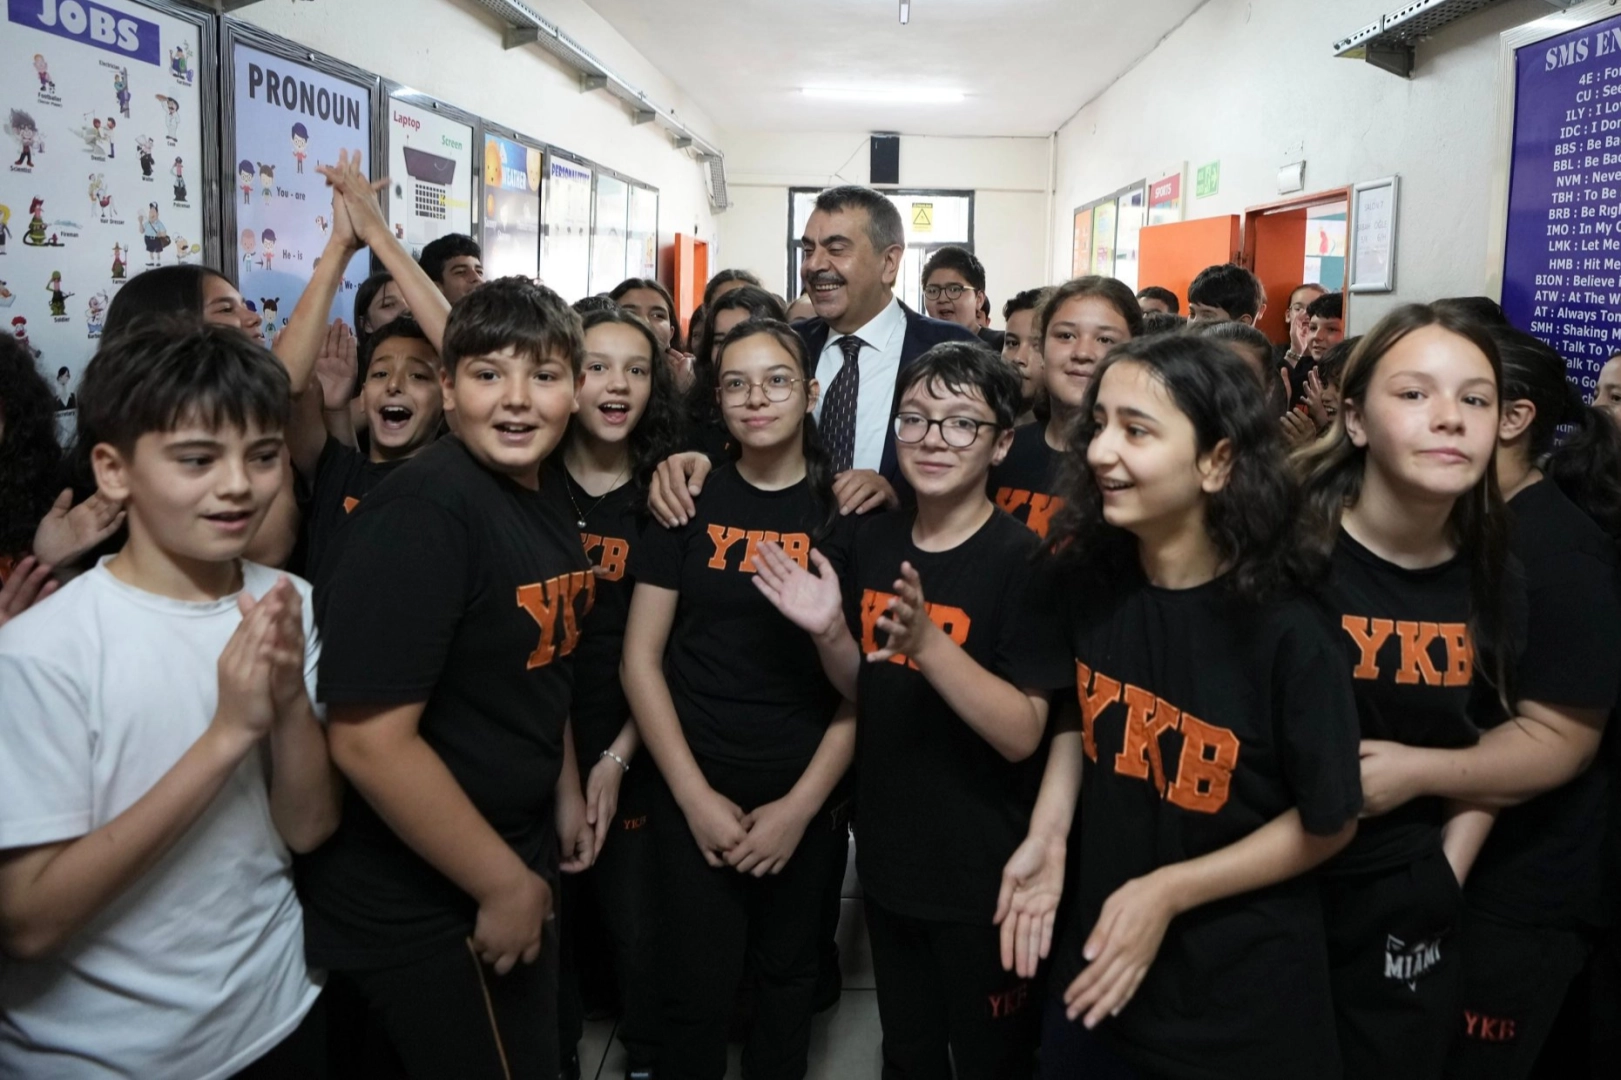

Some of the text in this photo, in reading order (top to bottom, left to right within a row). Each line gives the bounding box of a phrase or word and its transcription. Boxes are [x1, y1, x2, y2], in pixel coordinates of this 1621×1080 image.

[37, 0, 139, 51] JOBS
[1545, 37, 1589, 71] SMS
[1579, 72, 1593, 86] 4E
[249, 62, 360, 130] PRONOUN
[1576, 89, 1591, 103] CU
[393, 110, 421, 131] Laptop
[1566, 107, 1585, 122] ILY
[1596, 103, 1601, 116] I
[1560, 125, 1581, 139] IDC
[1591, 121, 1597, 133] I
[441, 134, 463, 151] Screen
[1554, 142, 1576, 156] BBS
[1586, 138, 1602, 151] Be
[1553, 159, 1574, 172] BBL
[1584, 156, 1599, 168] Be
[1556, 173, 1581, 187] NVM
[276, 186, 289, 198] You
[295, 192, 306, 201] are
[1552, 191, 1573, 204] TBH
[1584, 189, 1598, 201] To
[1601, 187, 1617, 199] Be
[1548, 207, 1571, 220] BRB
[1581, 206, 1596, 218] Be
[1547, 224, 1569, 236] IMO
[1579, 222, 1592, 235] In
[1595, 221, 1612, 236] My
[1548, 240, 1571, 251] LMK
[1581, 239, 1600, 251] Let
[1602, 238, 1620, 250] Me
[283, 249, 291, 259] He
[1549, 258, 1573, 270] HMB
[1583, 258, 1600, 270] Hit
[1604, 258, 1621, 270] Me
[1535, 274, 1563, 286] BION
[1573, 274, 1615, 288] Believe
[1534, 290, 1559, 302] ATW
[1568, 291, 1581, 303] At
[1584, 292, 1605, 304] The
[1534, 306, 1548, 317] AT
[1557, 307, 1597, 323] Always
[1530, 321, 1553, 334] SMH
[1562, 323, 1608, 341] Shaking
[1562, 340, 1585, 353] Talk
[1588, 342, 1603, 356] To
[1586, 359, 1600, 372] To
[996, 487, 1066, 540] YK
[1342, 614, 1474, 687] YKB
[1075, 658, 1240, 814] YKB
[1385, 938, 1441, 979] MIAMI
[1464, 1010, 1515, 1041] YKB
